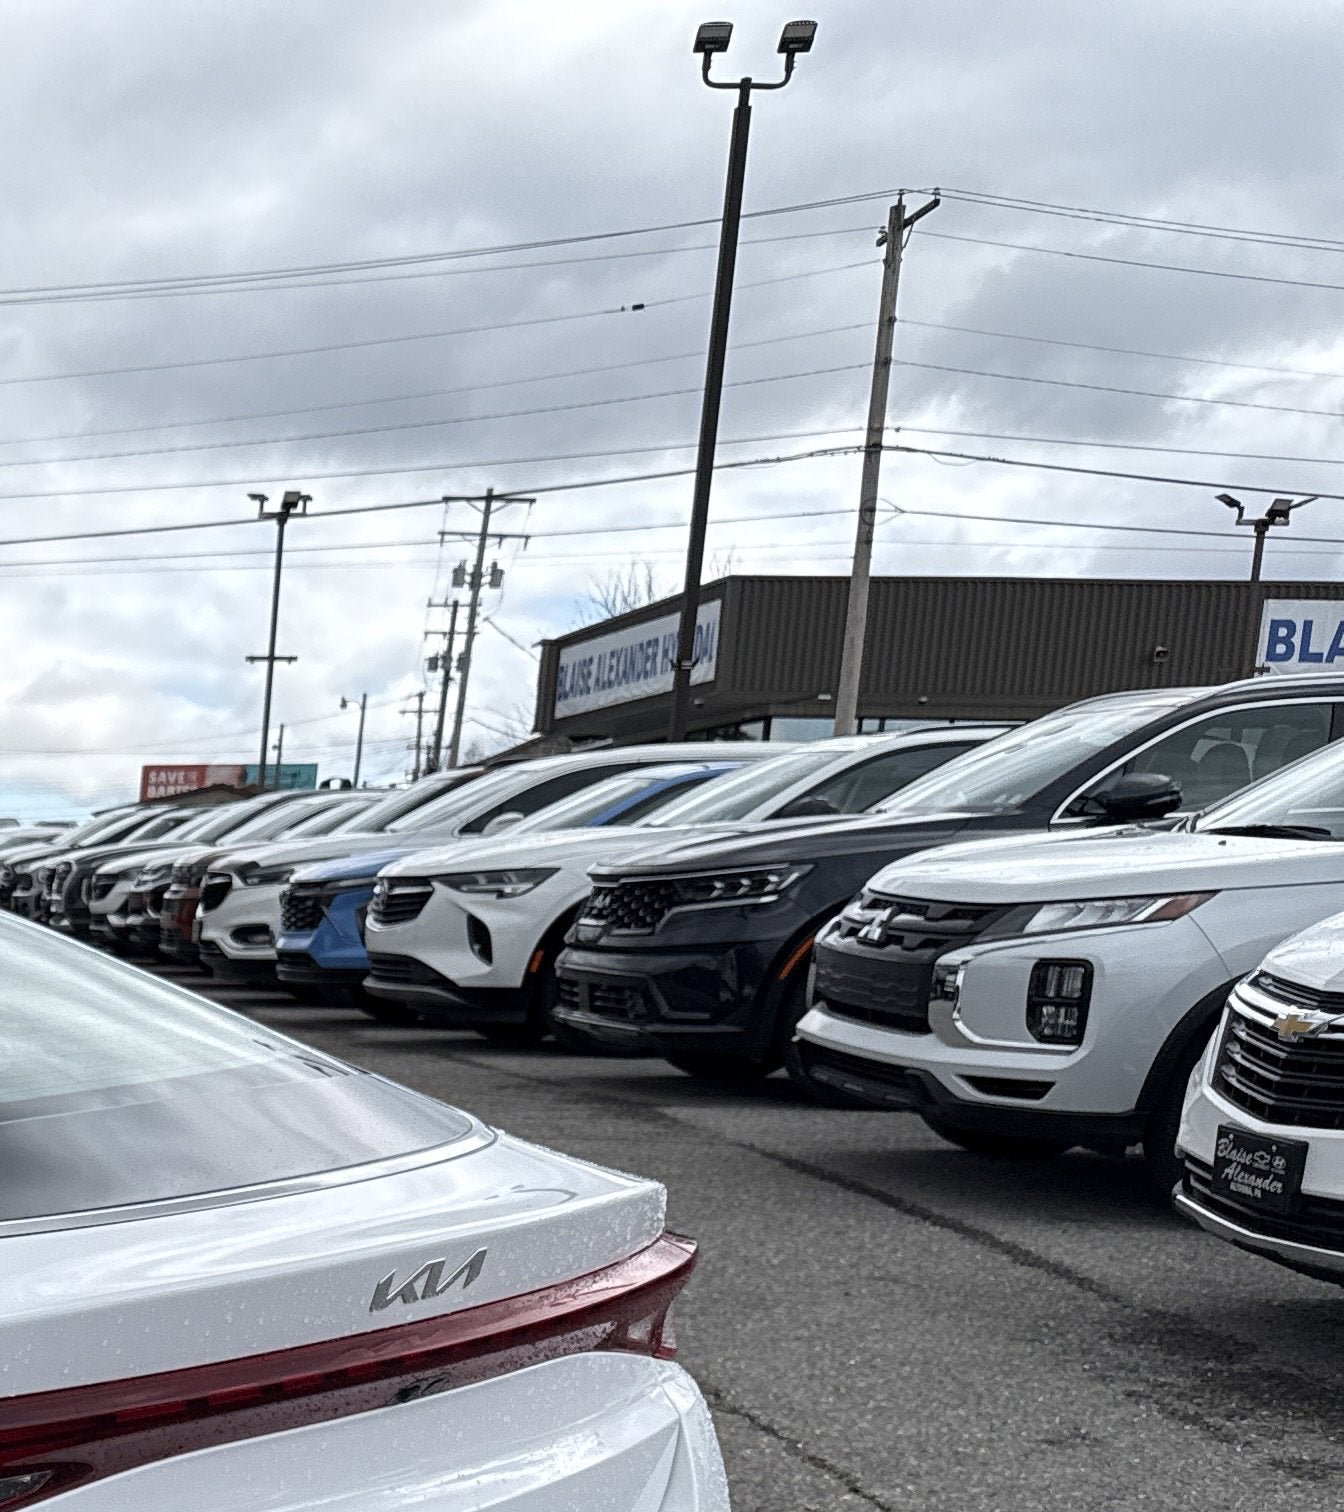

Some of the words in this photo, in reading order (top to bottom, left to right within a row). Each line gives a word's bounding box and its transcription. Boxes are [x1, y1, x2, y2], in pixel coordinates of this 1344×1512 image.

[557, 655, 594, 701] BLAISE
[593, 637, 659, 691] ALEXANDER
[660, 618, 717, 676] HYDAI
[1221, 1162, 1283, 1193] Alexander
[369, 1246, 487, 1312] KIA
